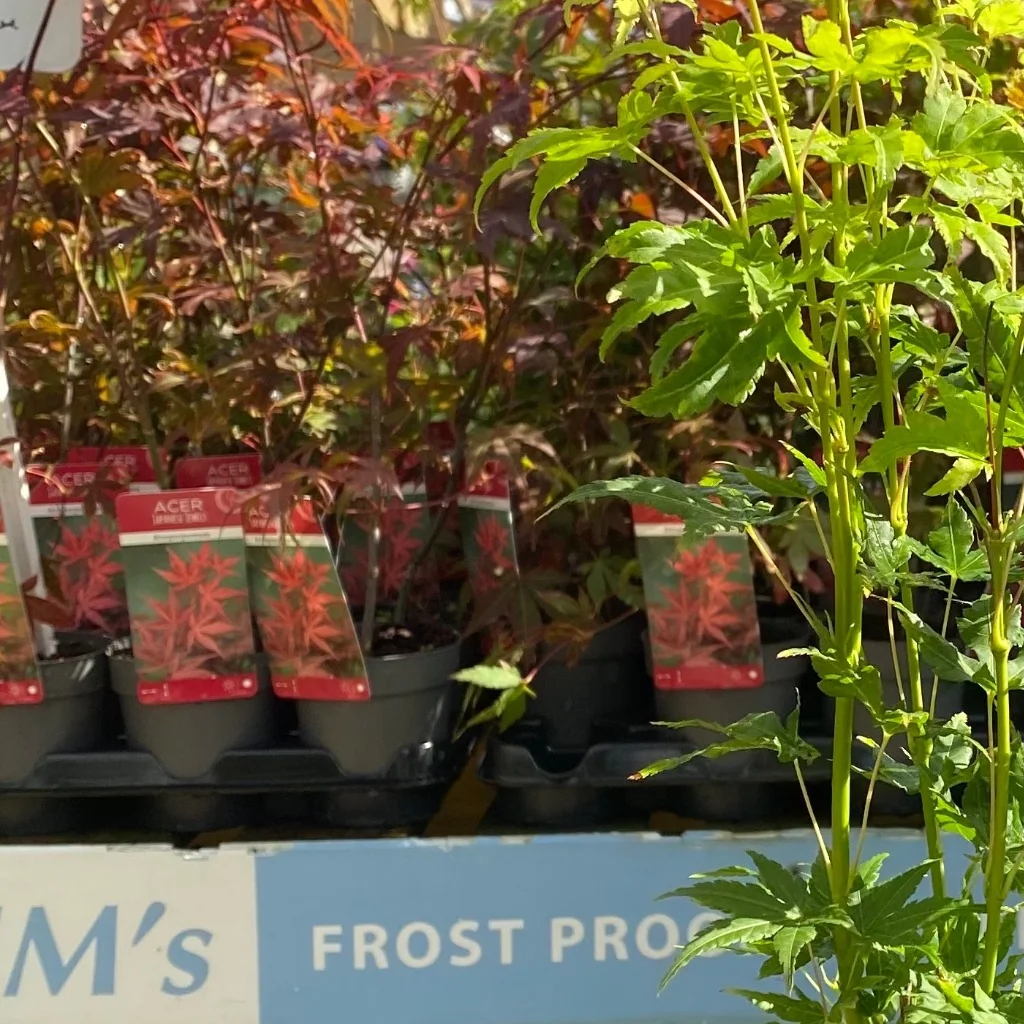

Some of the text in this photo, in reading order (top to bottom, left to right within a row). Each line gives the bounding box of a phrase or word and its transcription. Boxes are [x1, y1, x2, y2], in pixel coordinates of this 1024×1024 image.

[207, 462, 250, 477] ACER
[153, 497, 204, 514] ACER
[0, 901, 214, 998] M's
[311, 918, 525, 972] FROST
